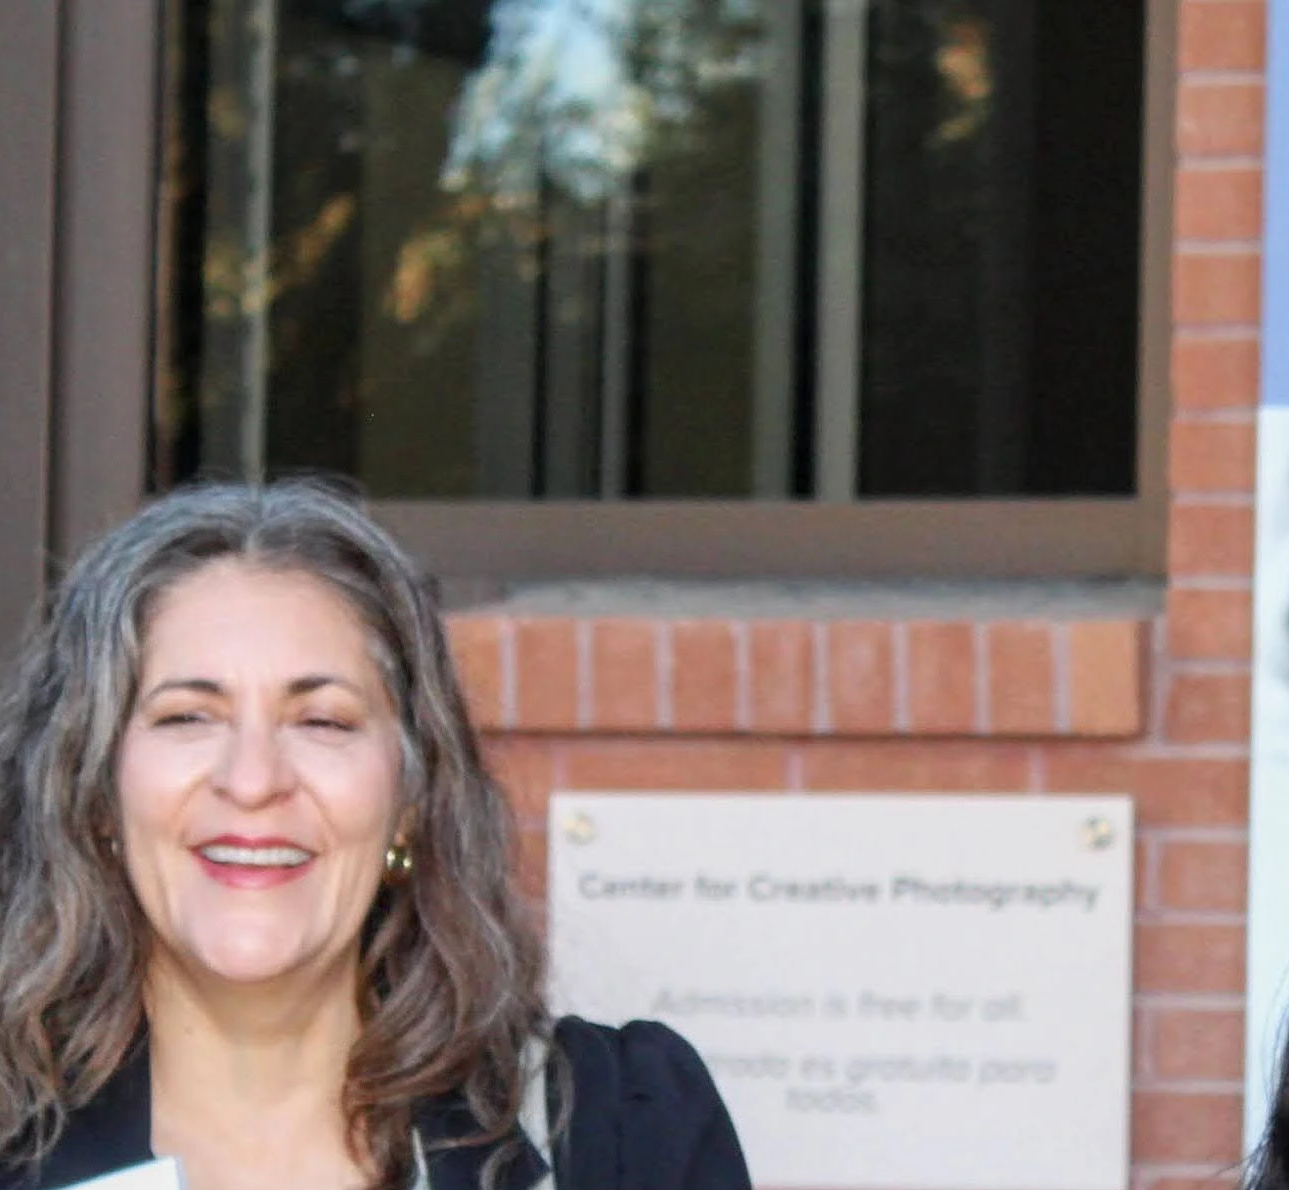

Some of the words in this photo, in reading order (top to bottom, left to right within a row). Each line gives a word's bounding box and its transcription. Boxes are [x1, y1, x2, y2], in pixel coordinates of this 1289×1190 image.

[578, 872, 683, 900] Center
[694, 873, 738, 901] for
[747, 874, 880, 904] Creative
[891, 875, 1100, 911] Photography
[652, 990, 812, 1018] Admission
[827, 991, 849, 1019] is
[857, 990, 921, 1020] free
[931, 991, 968, 1021] for
